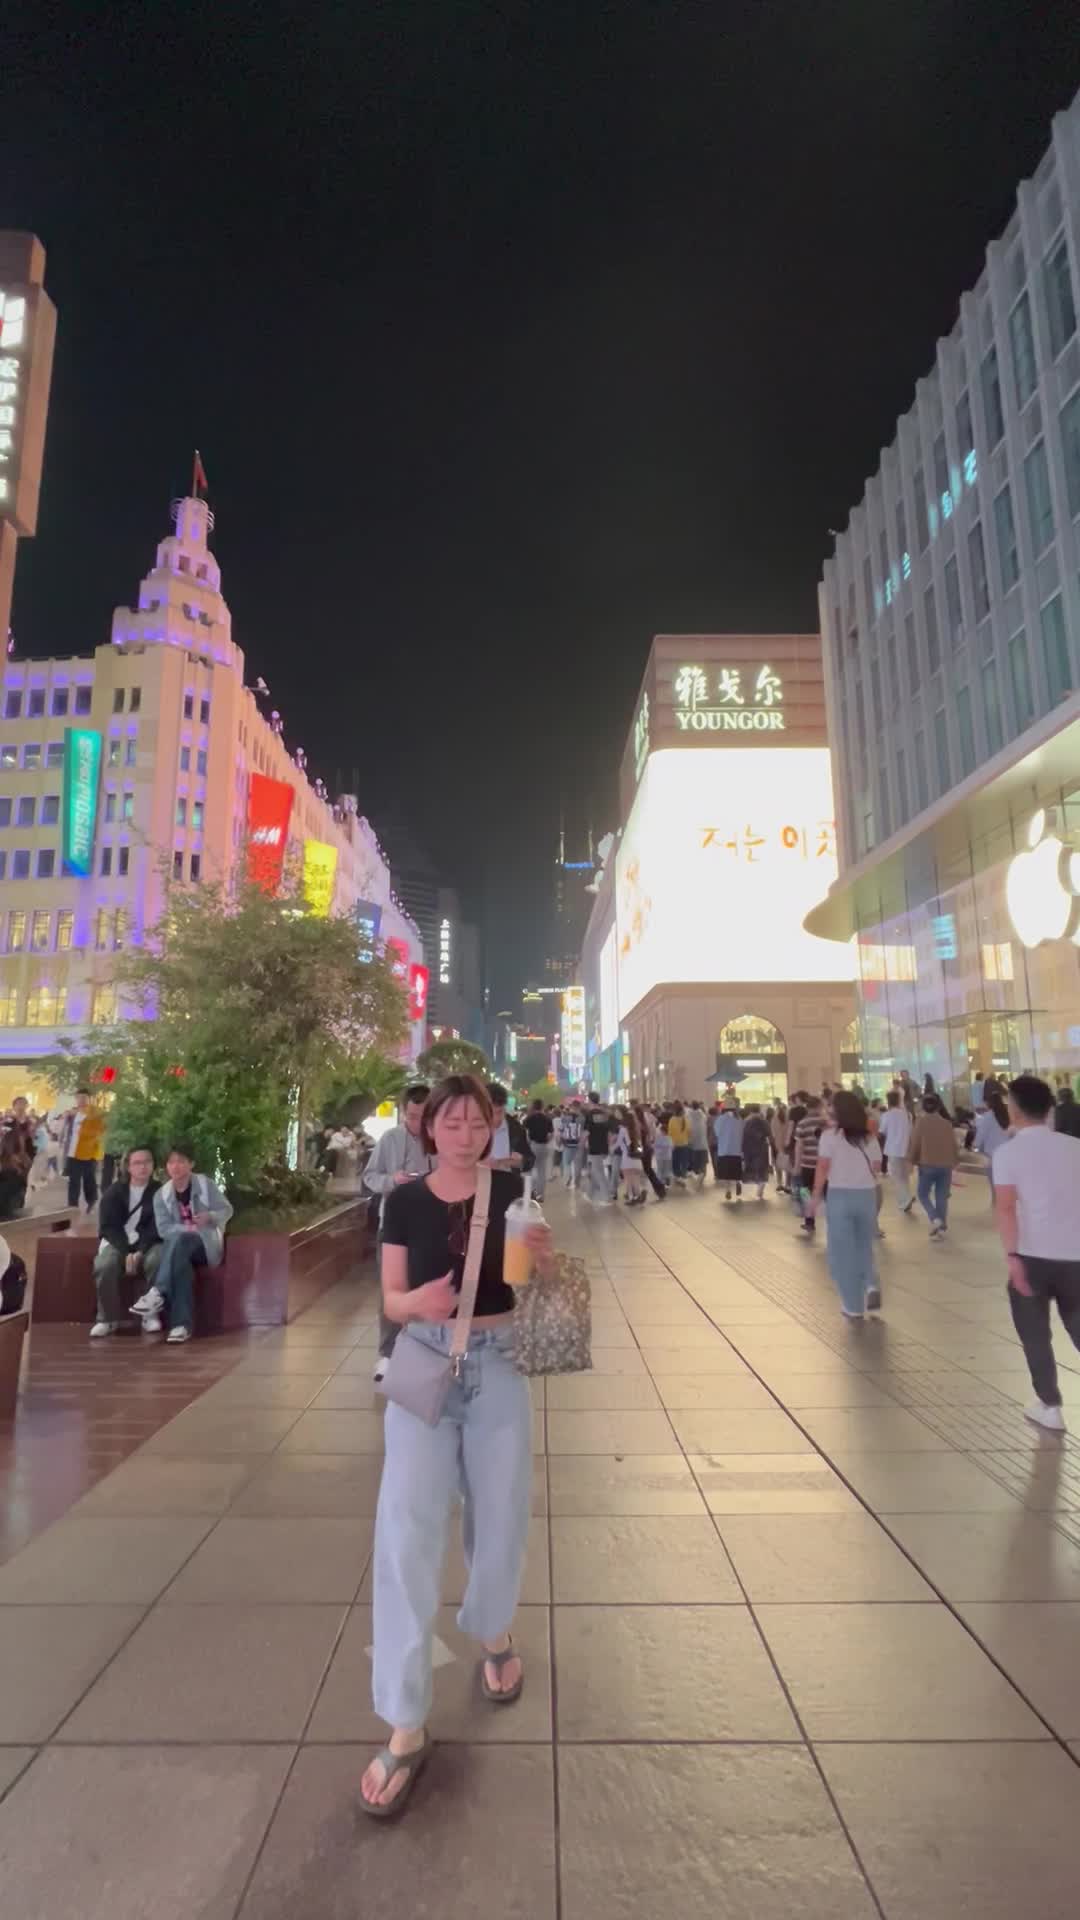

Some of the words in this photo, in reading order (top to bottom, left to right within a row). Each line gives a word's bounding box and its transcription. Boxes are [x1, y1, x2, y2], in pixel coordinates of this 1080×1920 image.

[675, 665, 783, 711] 雅戈尔
[676, 711, 786, 730] YOUNGOR
[701, 824, 766, 861] 저는
